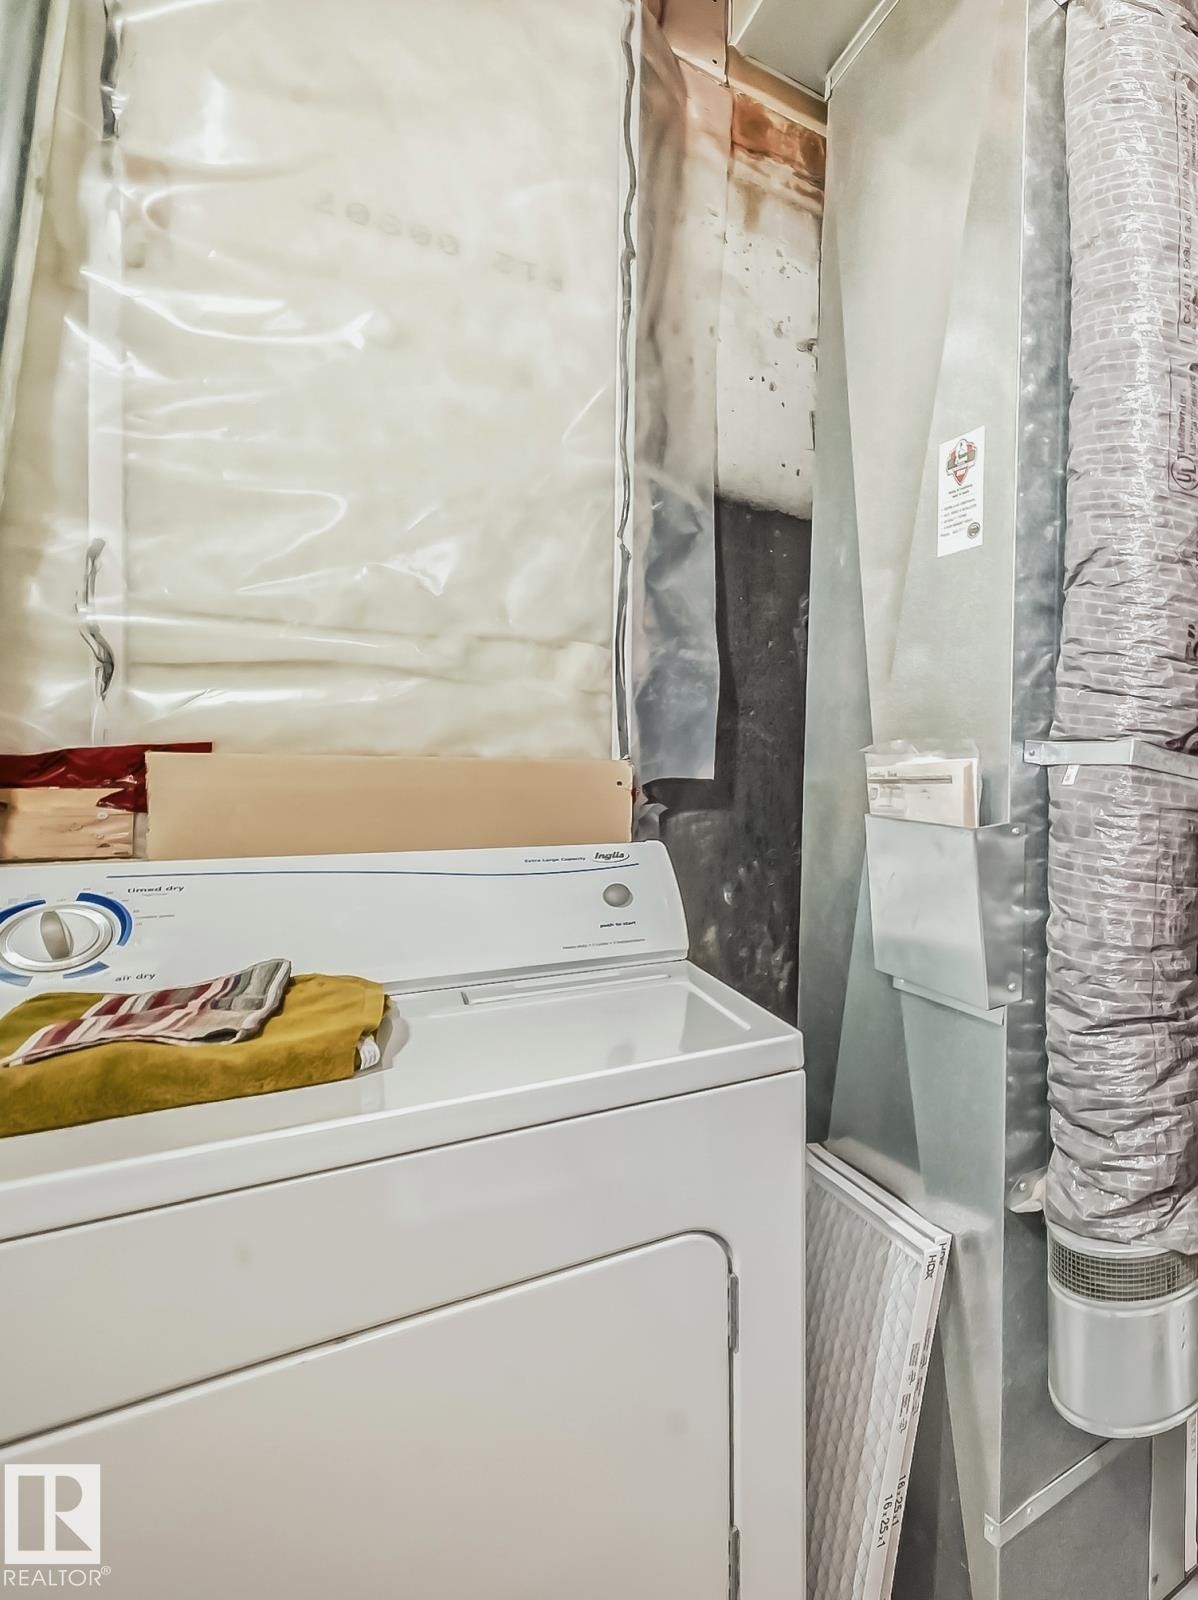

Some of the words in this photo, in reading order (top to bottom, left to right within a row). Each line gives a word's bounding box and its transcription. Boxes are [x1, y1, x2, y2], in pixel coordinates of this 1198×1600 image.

[594, 851, 625, 861] Inglis
[127, 886, 162, 894] timed
[136, 972, 157, 981] dry
[925, 1253, 938, 1281] HDX
